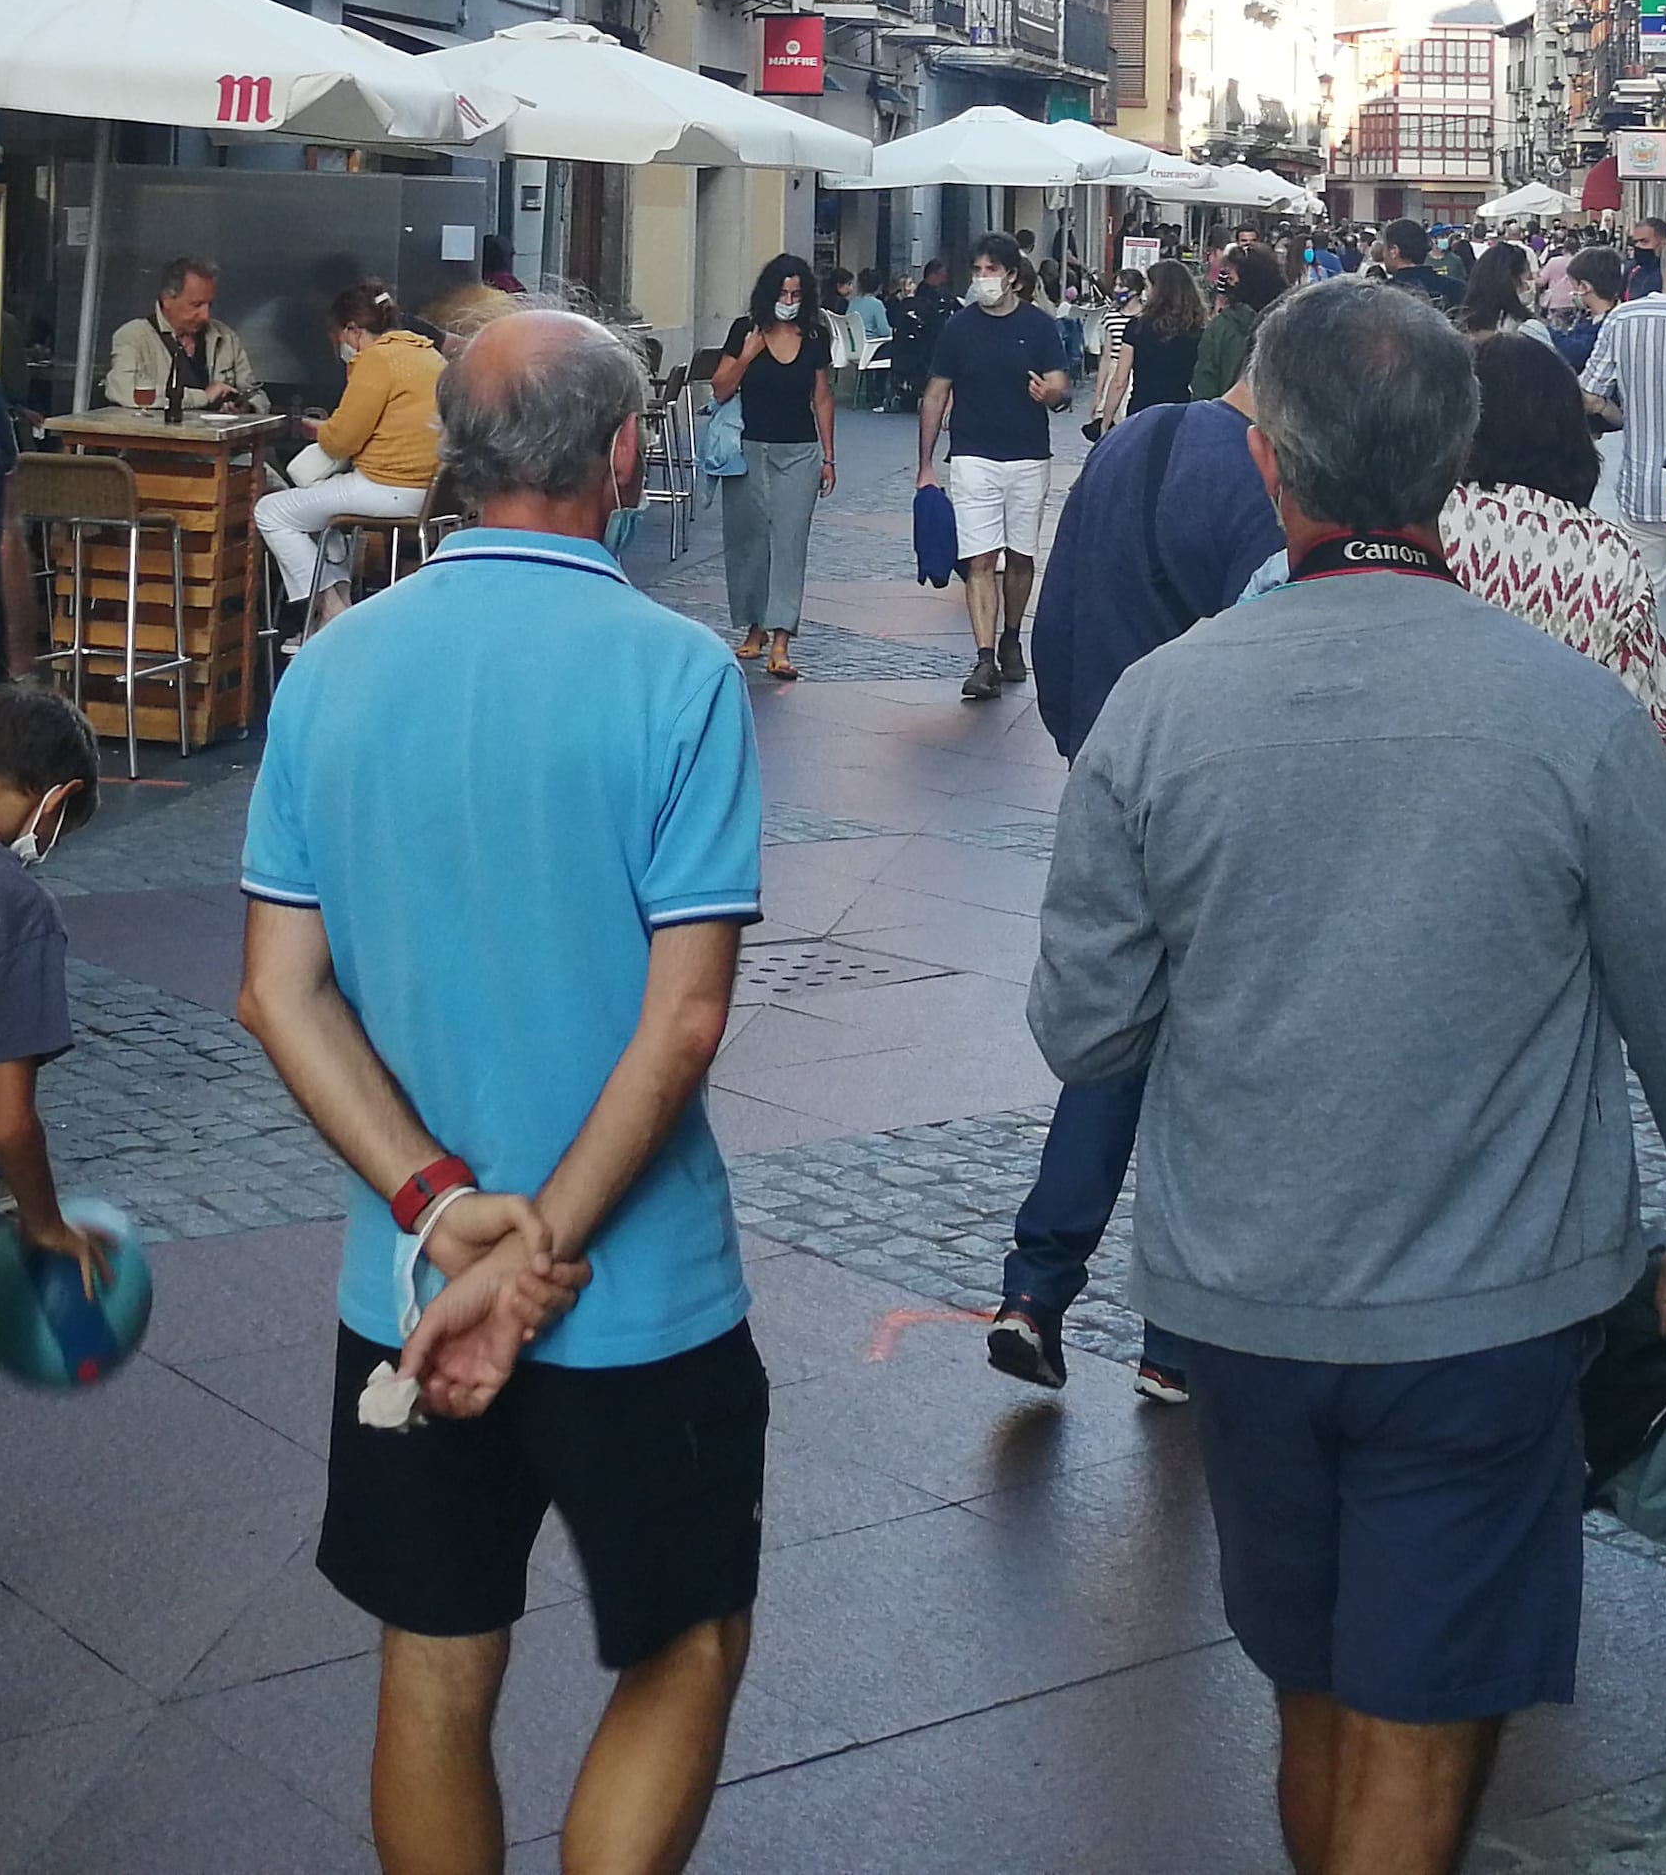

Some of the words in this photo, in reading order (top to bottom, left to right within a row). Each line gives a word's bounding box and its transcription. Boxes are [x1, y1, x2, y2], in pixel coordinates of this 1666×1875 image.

[768, 56, 818, 66] MAPFRE
[1151, 169, 1199, 180] Cruzcampo
[1344, 541, 1429, 566] Canon
